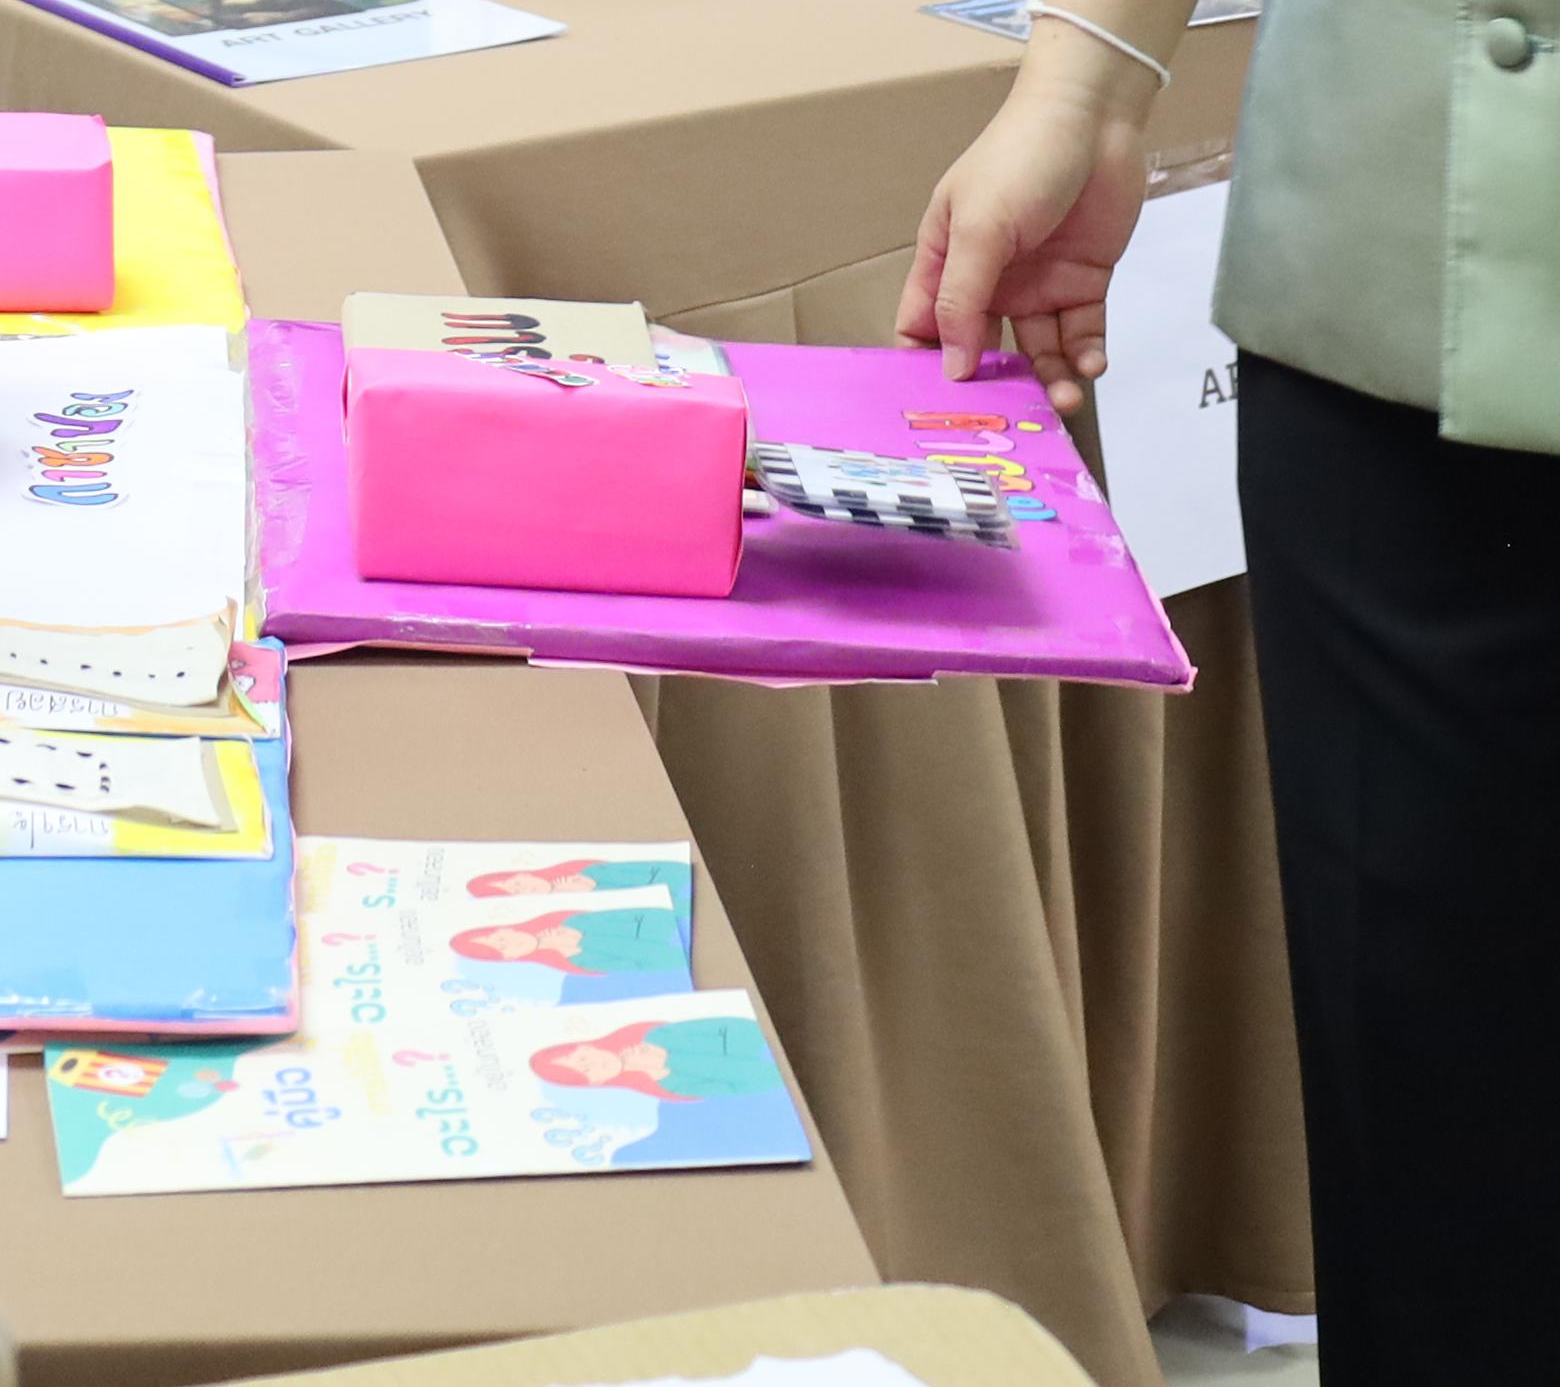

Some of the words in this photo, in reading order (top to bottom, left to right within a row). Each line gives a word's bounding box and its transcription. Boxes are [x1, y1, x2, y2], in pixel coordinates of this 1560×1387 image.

[221, 31, 284, 49] ART
[293, 8, 434, 37] GALLERY
[6, 690, 119, 720] การสอย
[261, 1066, 343, 1129] คู่มือ
